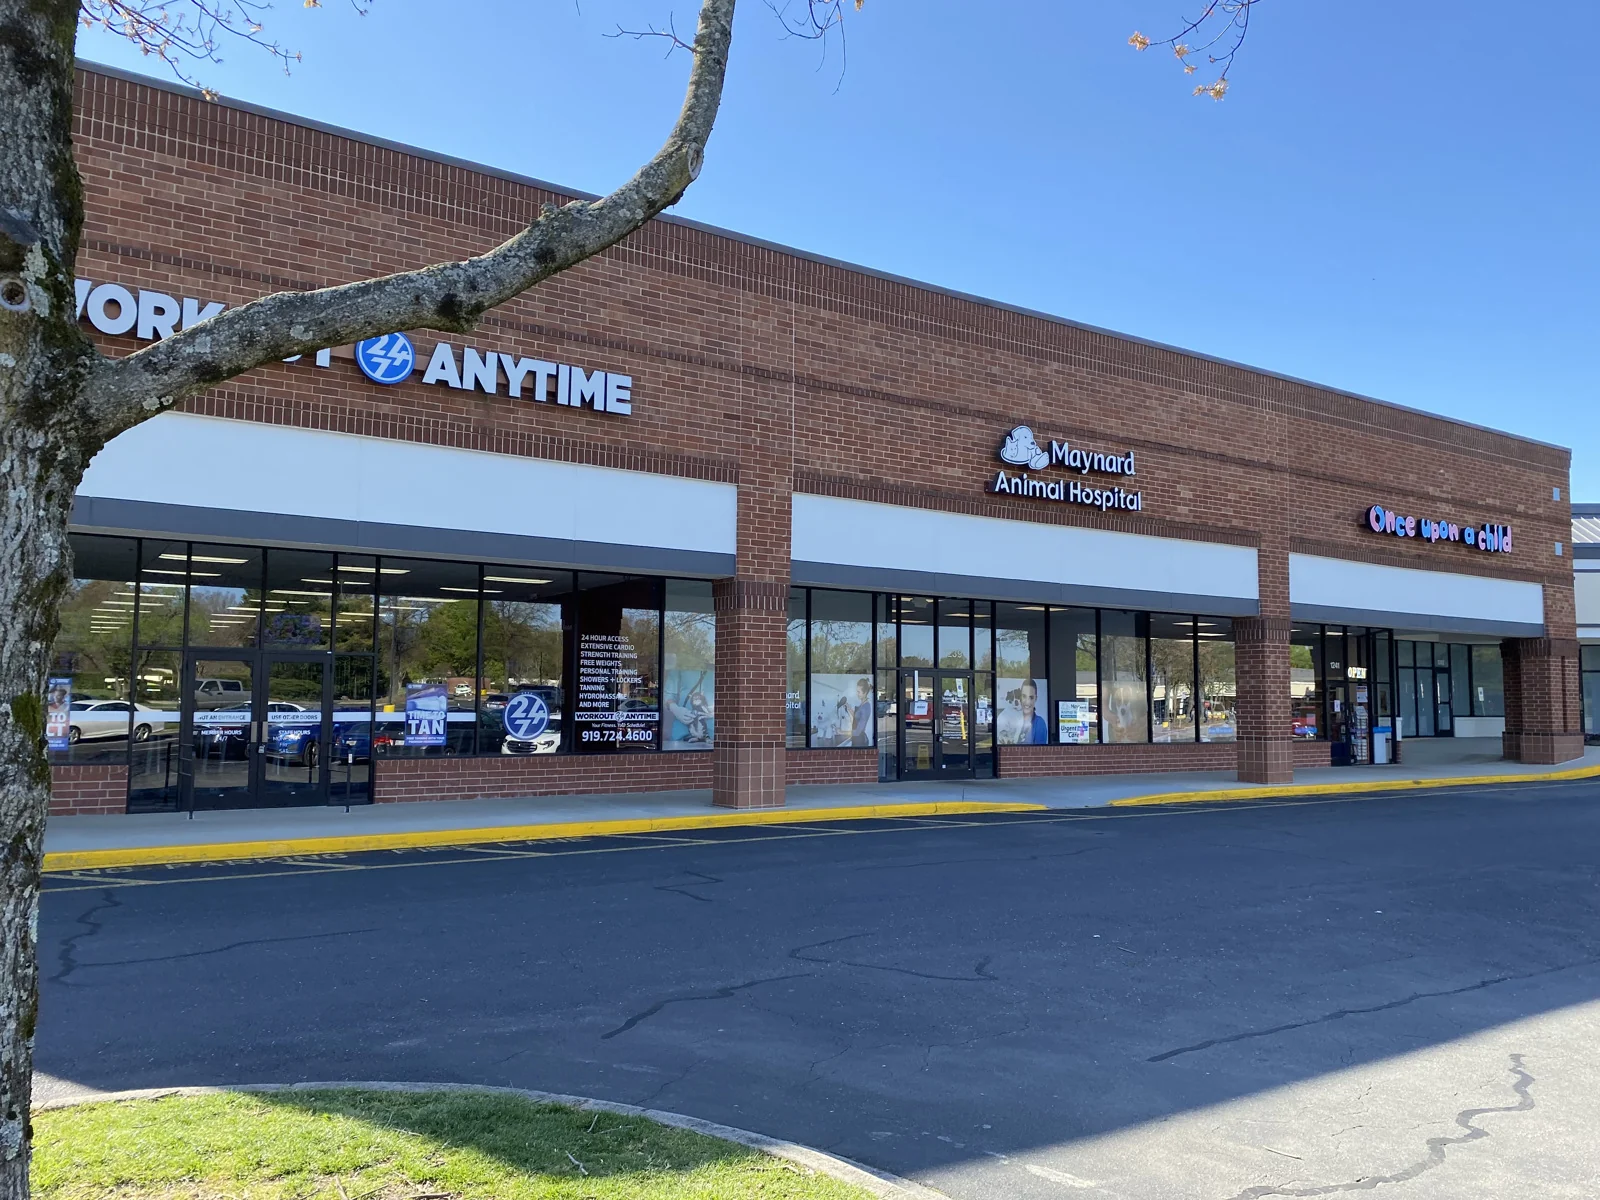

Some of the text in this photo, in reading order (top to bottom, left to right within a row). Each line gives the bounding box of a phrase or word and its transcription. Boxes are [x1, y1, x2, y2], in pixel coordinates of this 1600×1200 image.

[421, 342, 632, 416] ANYTIME
[1052, 440, 1136, 475] Maynard
[994, 470, 1142, 512] Animal Hospital
[1369, 504, 1512, 553] Once upon a child
[580, 642, 613, 650] EXTENSIVE
[580, 667, 611, 675] PERSONAL
[1348, 666, 1367, 679] OPEN
[580, 675, 609, 683] SHOWERS
[49, 712, 66, 723] TO
[408, 720, 445, 735] TAN
[582, 730, 653, 742] 919.724.4600
